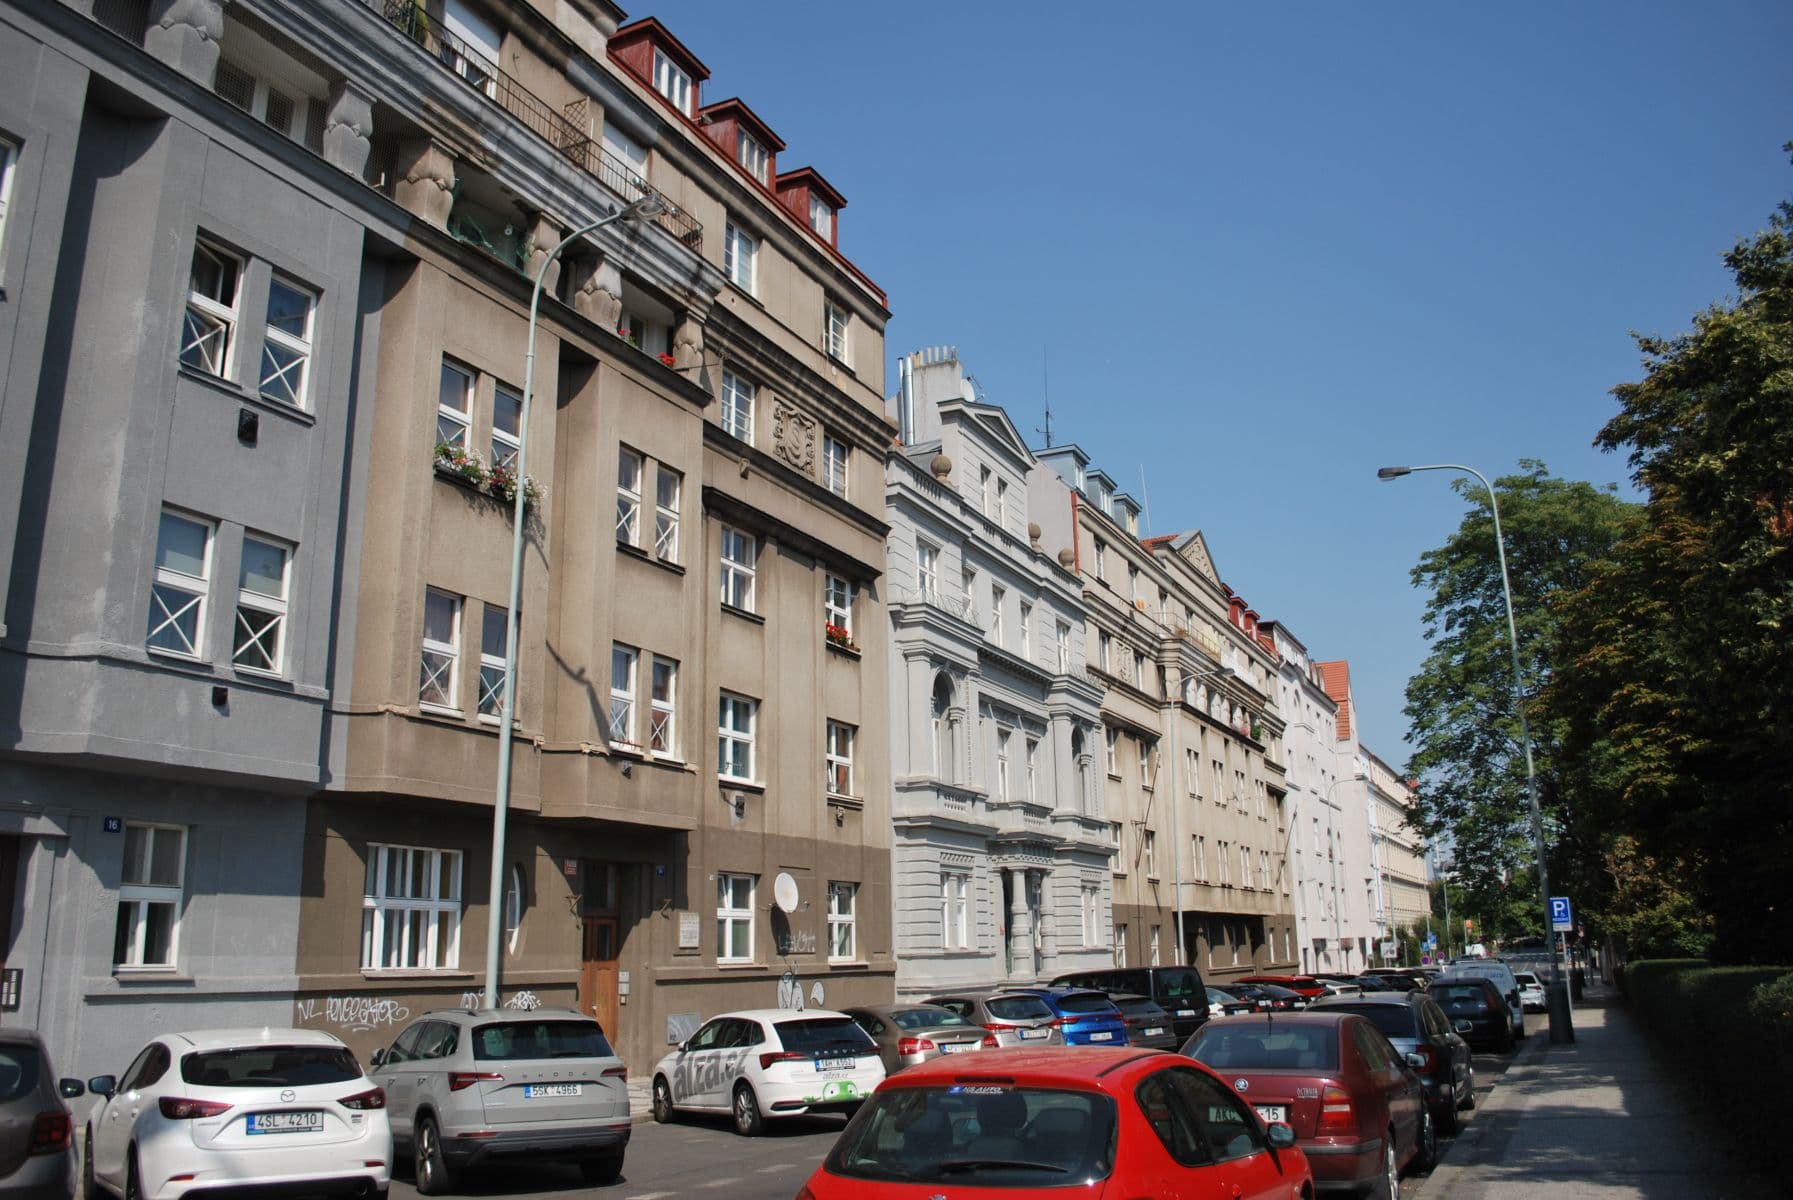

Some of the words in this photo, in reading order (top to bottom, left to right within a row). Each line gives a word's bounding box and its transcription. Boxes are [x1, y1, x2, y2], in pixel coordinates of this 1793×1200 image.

[108, 819, 118, 830] 16
[1553, 901, 1565, 917] P
[556, 1083, 578, 1096] 4966
[258, 1114, 279, 1128] 4SL
[289, 1111, 317, 1126] 4210
